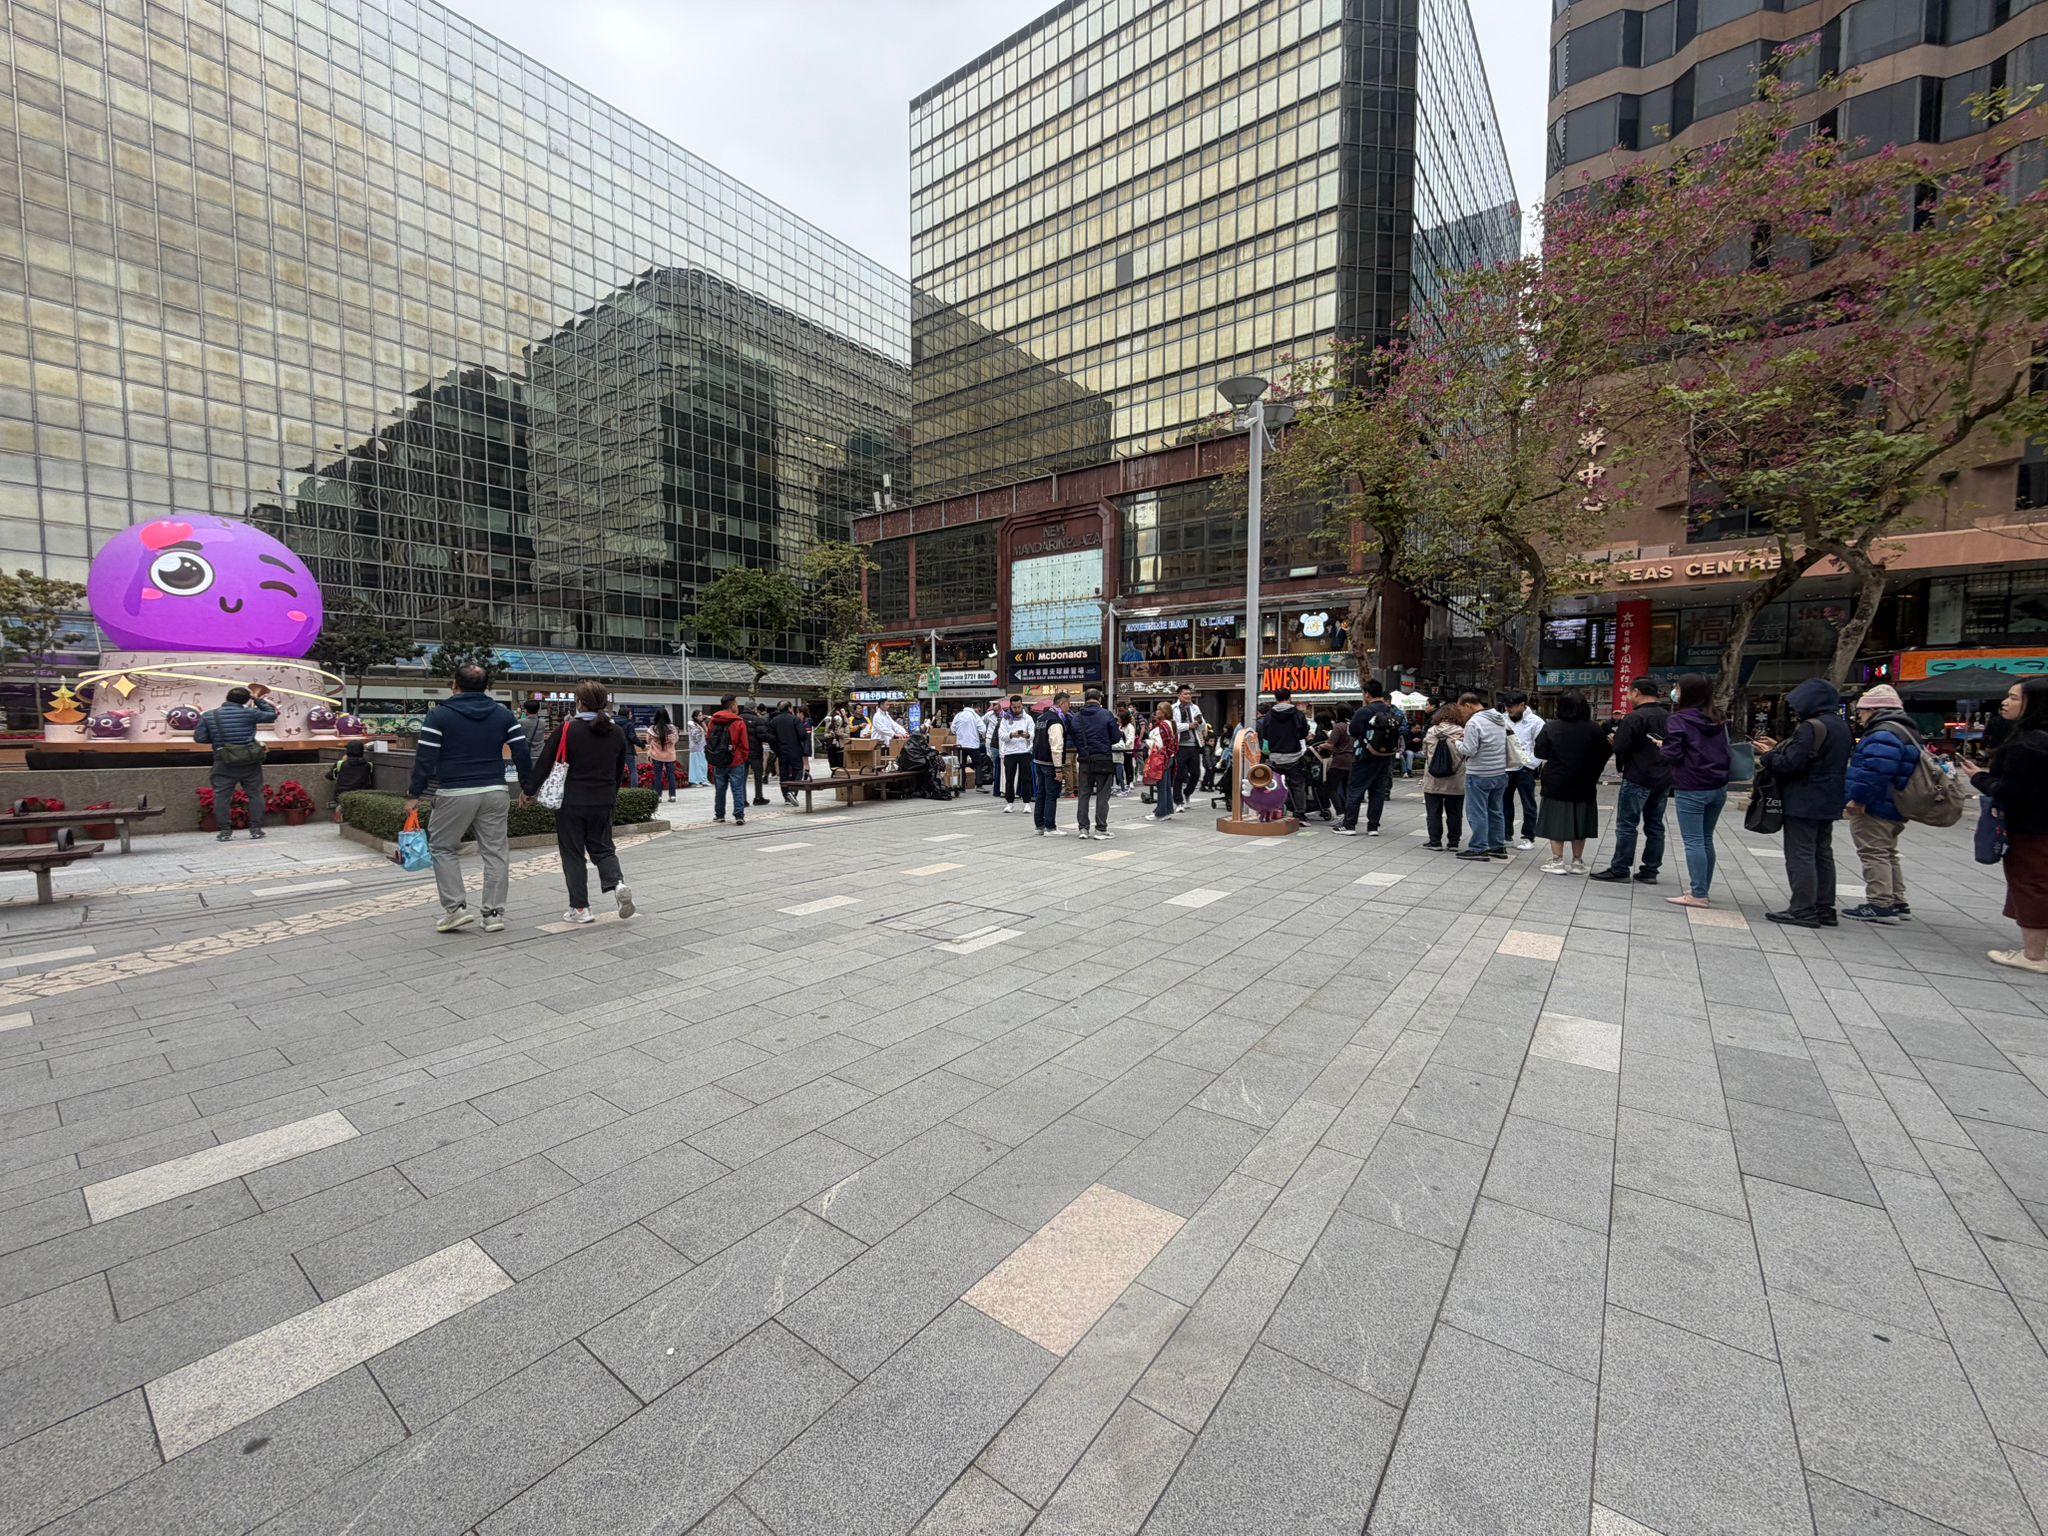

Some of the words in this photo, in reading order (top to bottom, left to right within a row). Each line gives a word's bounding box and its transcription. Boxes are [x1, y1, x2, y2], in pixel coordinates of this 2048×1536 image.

[1042, 522, 1067, 538] NEW
[1013, 537, 1065, 556] MANDARIN
[1065, 531, 1102, 549] PLAZA
[1685, 555, 1782, 578] CENTRE
[1037, 650, 1089, 661] McDonald's
[1262, 665, 1331, 691] AWESOME
[1545, 670, 1610, 684] 南洋中心
